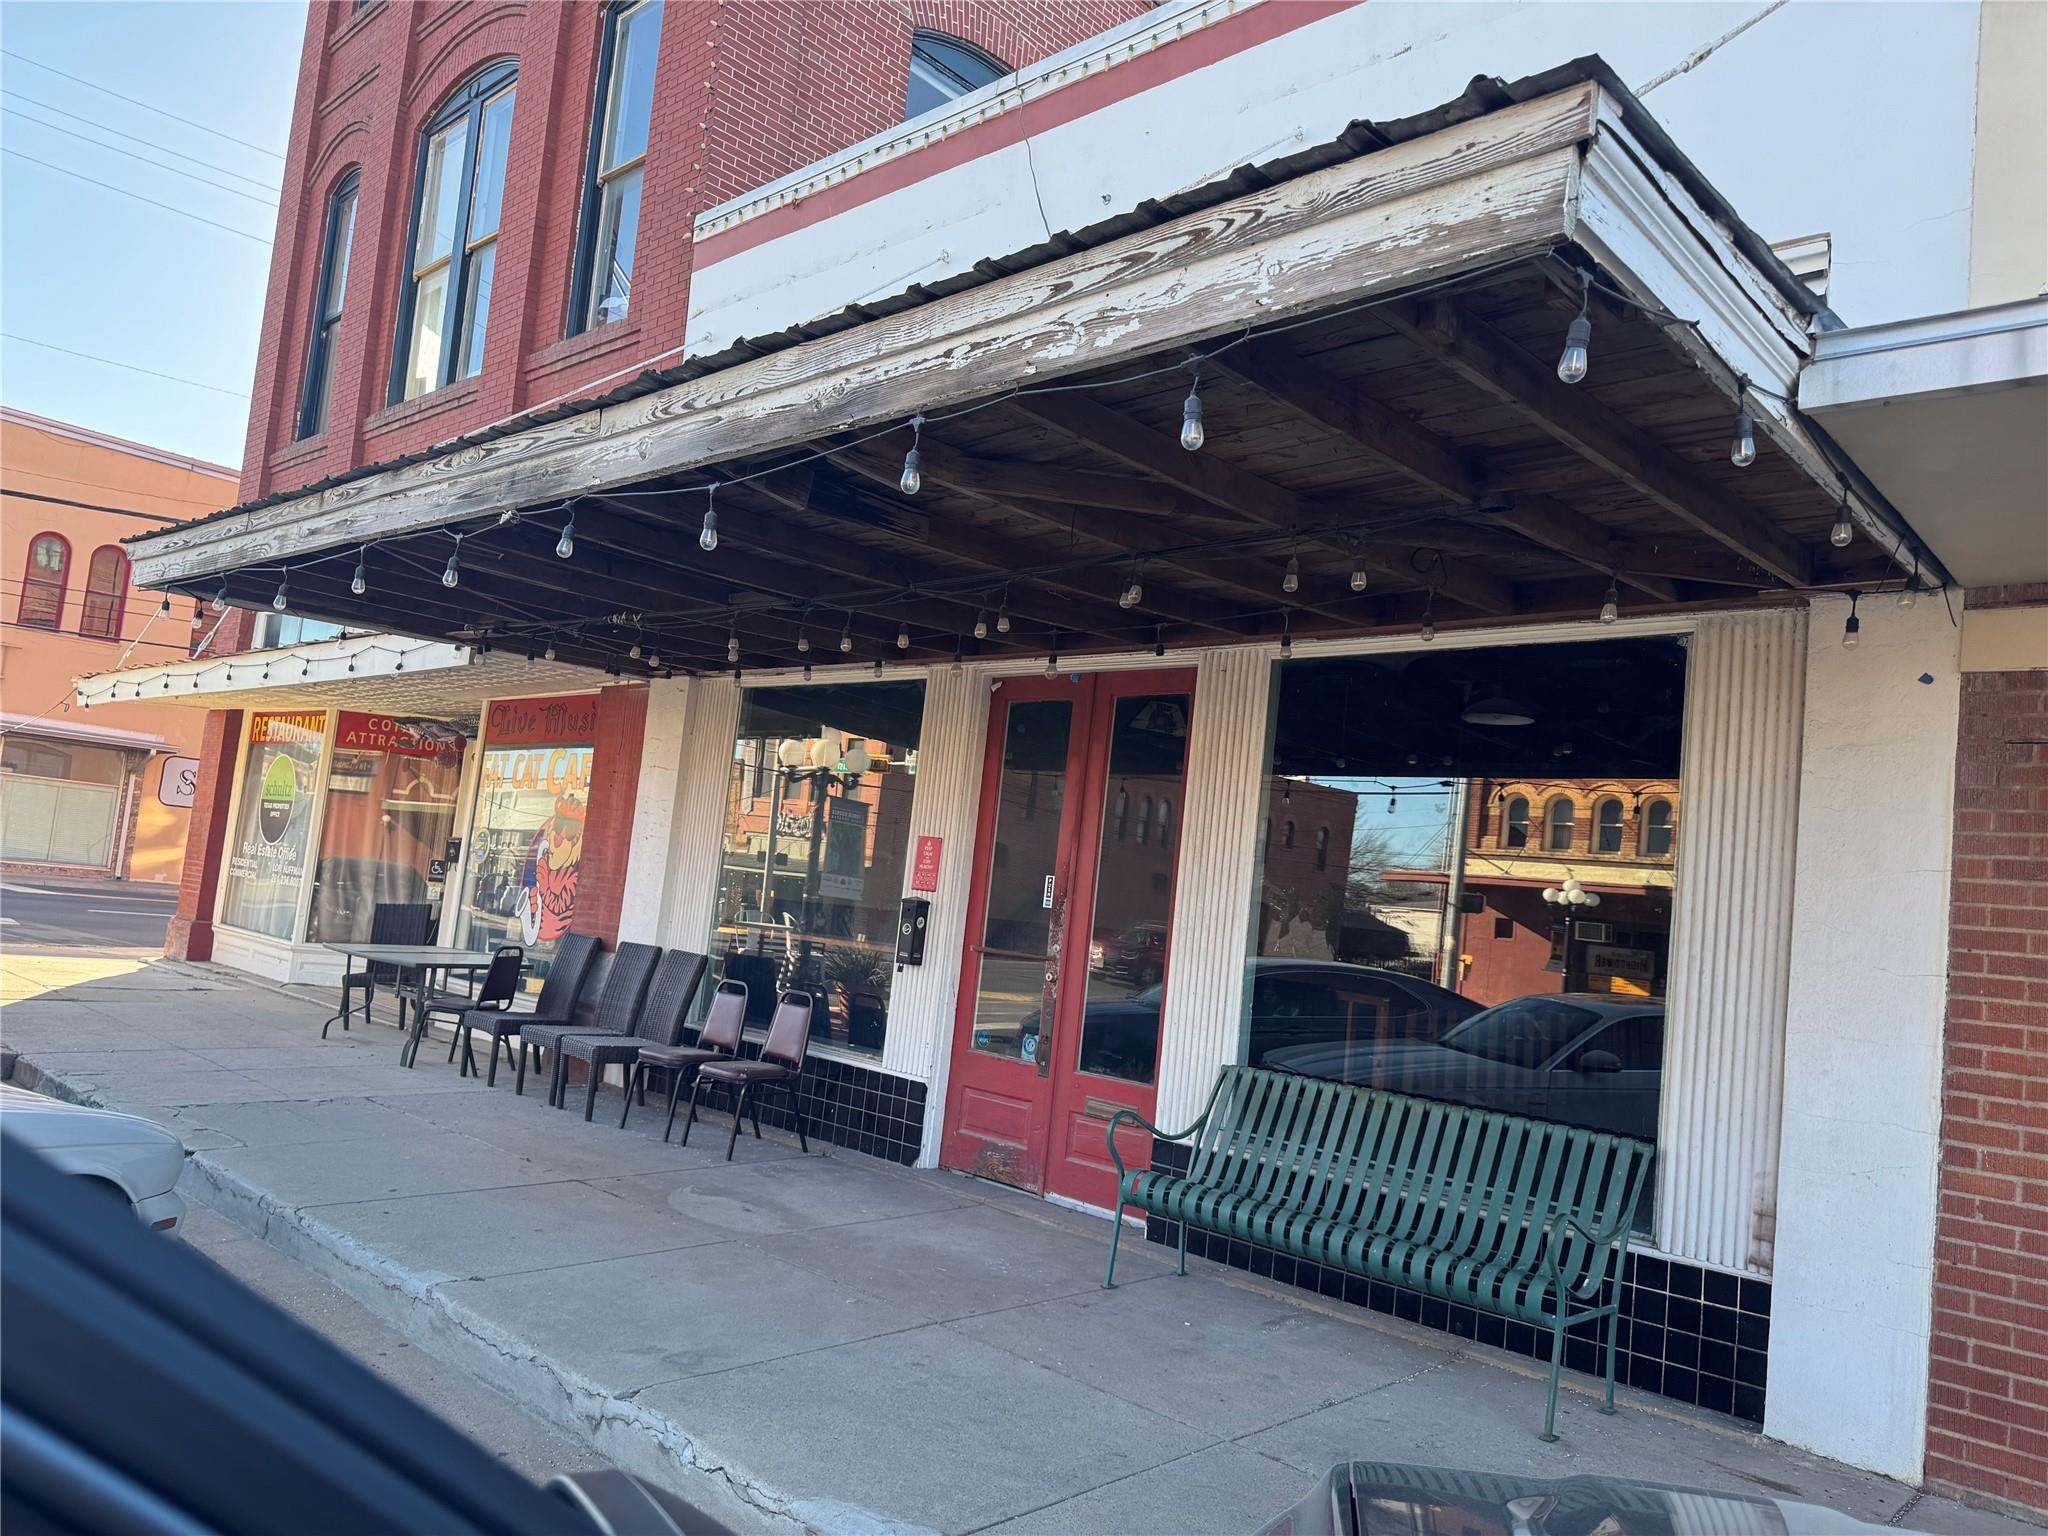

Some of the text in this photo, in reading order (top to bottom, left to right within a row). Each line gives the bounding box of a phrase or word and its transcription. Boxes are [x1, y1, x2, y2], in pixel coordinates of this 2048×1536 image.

[252, 715, 326, 742] RESTAURANT
[491, 704, 536, 736] Live
[512, 753, 545, 789] CAT
[265, 780, 293, 796] schultz
[242, 841, 257, 855] Real
